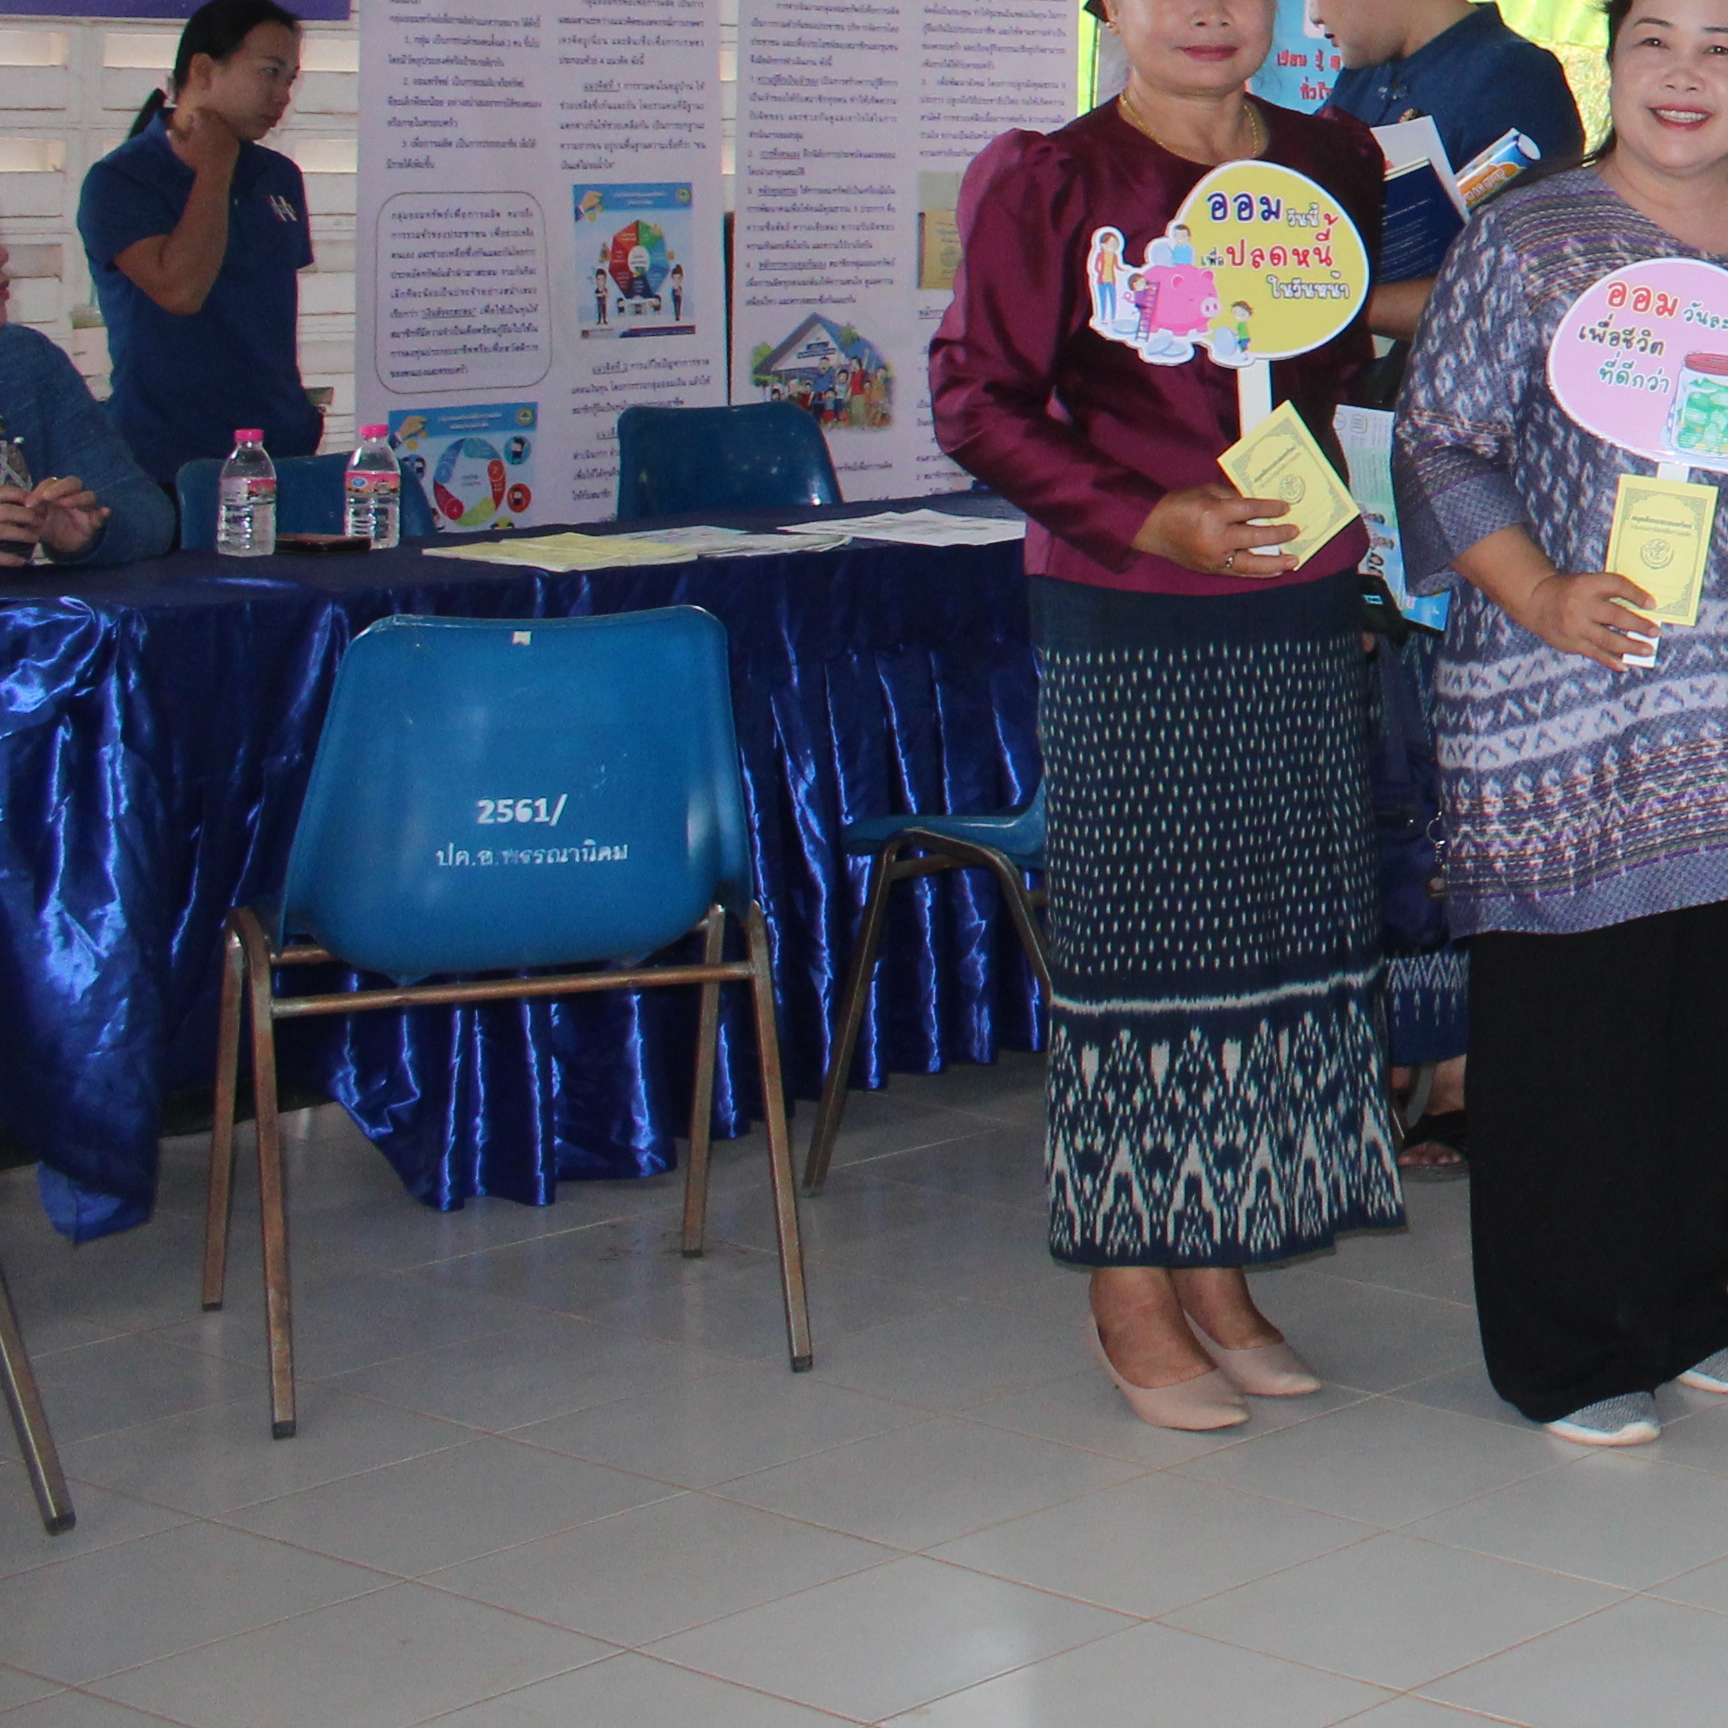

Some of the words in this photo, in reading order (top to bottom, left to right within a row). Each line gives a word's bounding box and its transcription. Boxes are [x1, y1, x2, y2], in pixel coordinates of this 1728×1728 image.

[1206, 192, 1281, 222] ออม
[1287, 203, 1320, 228] วันนี้
[1201, 247, 1225, 267] เพื่อ
[1226, 213, 1340, 268] ปลดหนี้
[1266, 270, 1350, 299] ในวันหน้า
[1606, 281, 1679, 317] ออม
[1578, 313, 1665, 356] เพื่อชีวิต
[1598, 351, 1670, 394] ที่ดีกว่า
[476, 793, 569, 827] 2561/
